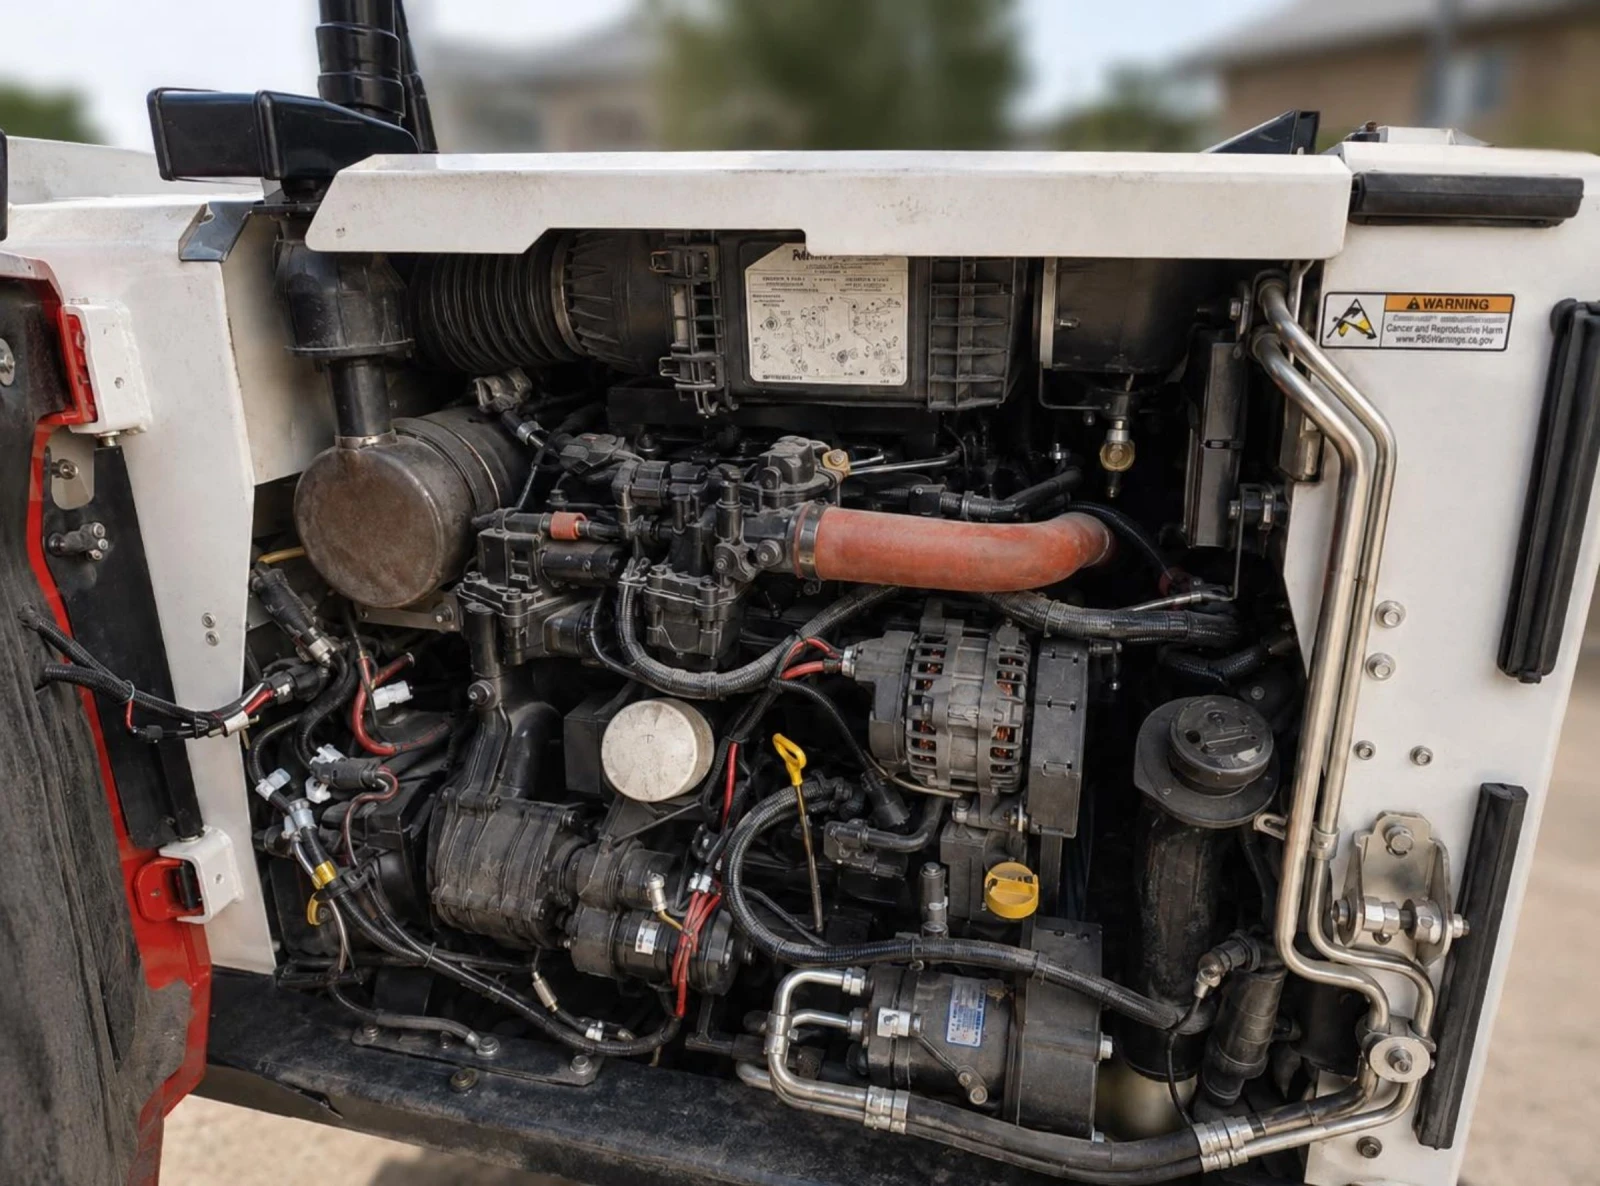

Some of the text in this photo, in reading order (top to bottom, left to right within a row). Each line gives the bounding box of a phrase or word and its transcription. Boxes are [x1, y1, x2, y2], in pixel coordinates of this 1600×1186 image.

[1423, 298, 1489, 310] WARNING
[1386, 324, 1503, 334] Cancer and Reproductive Harm
